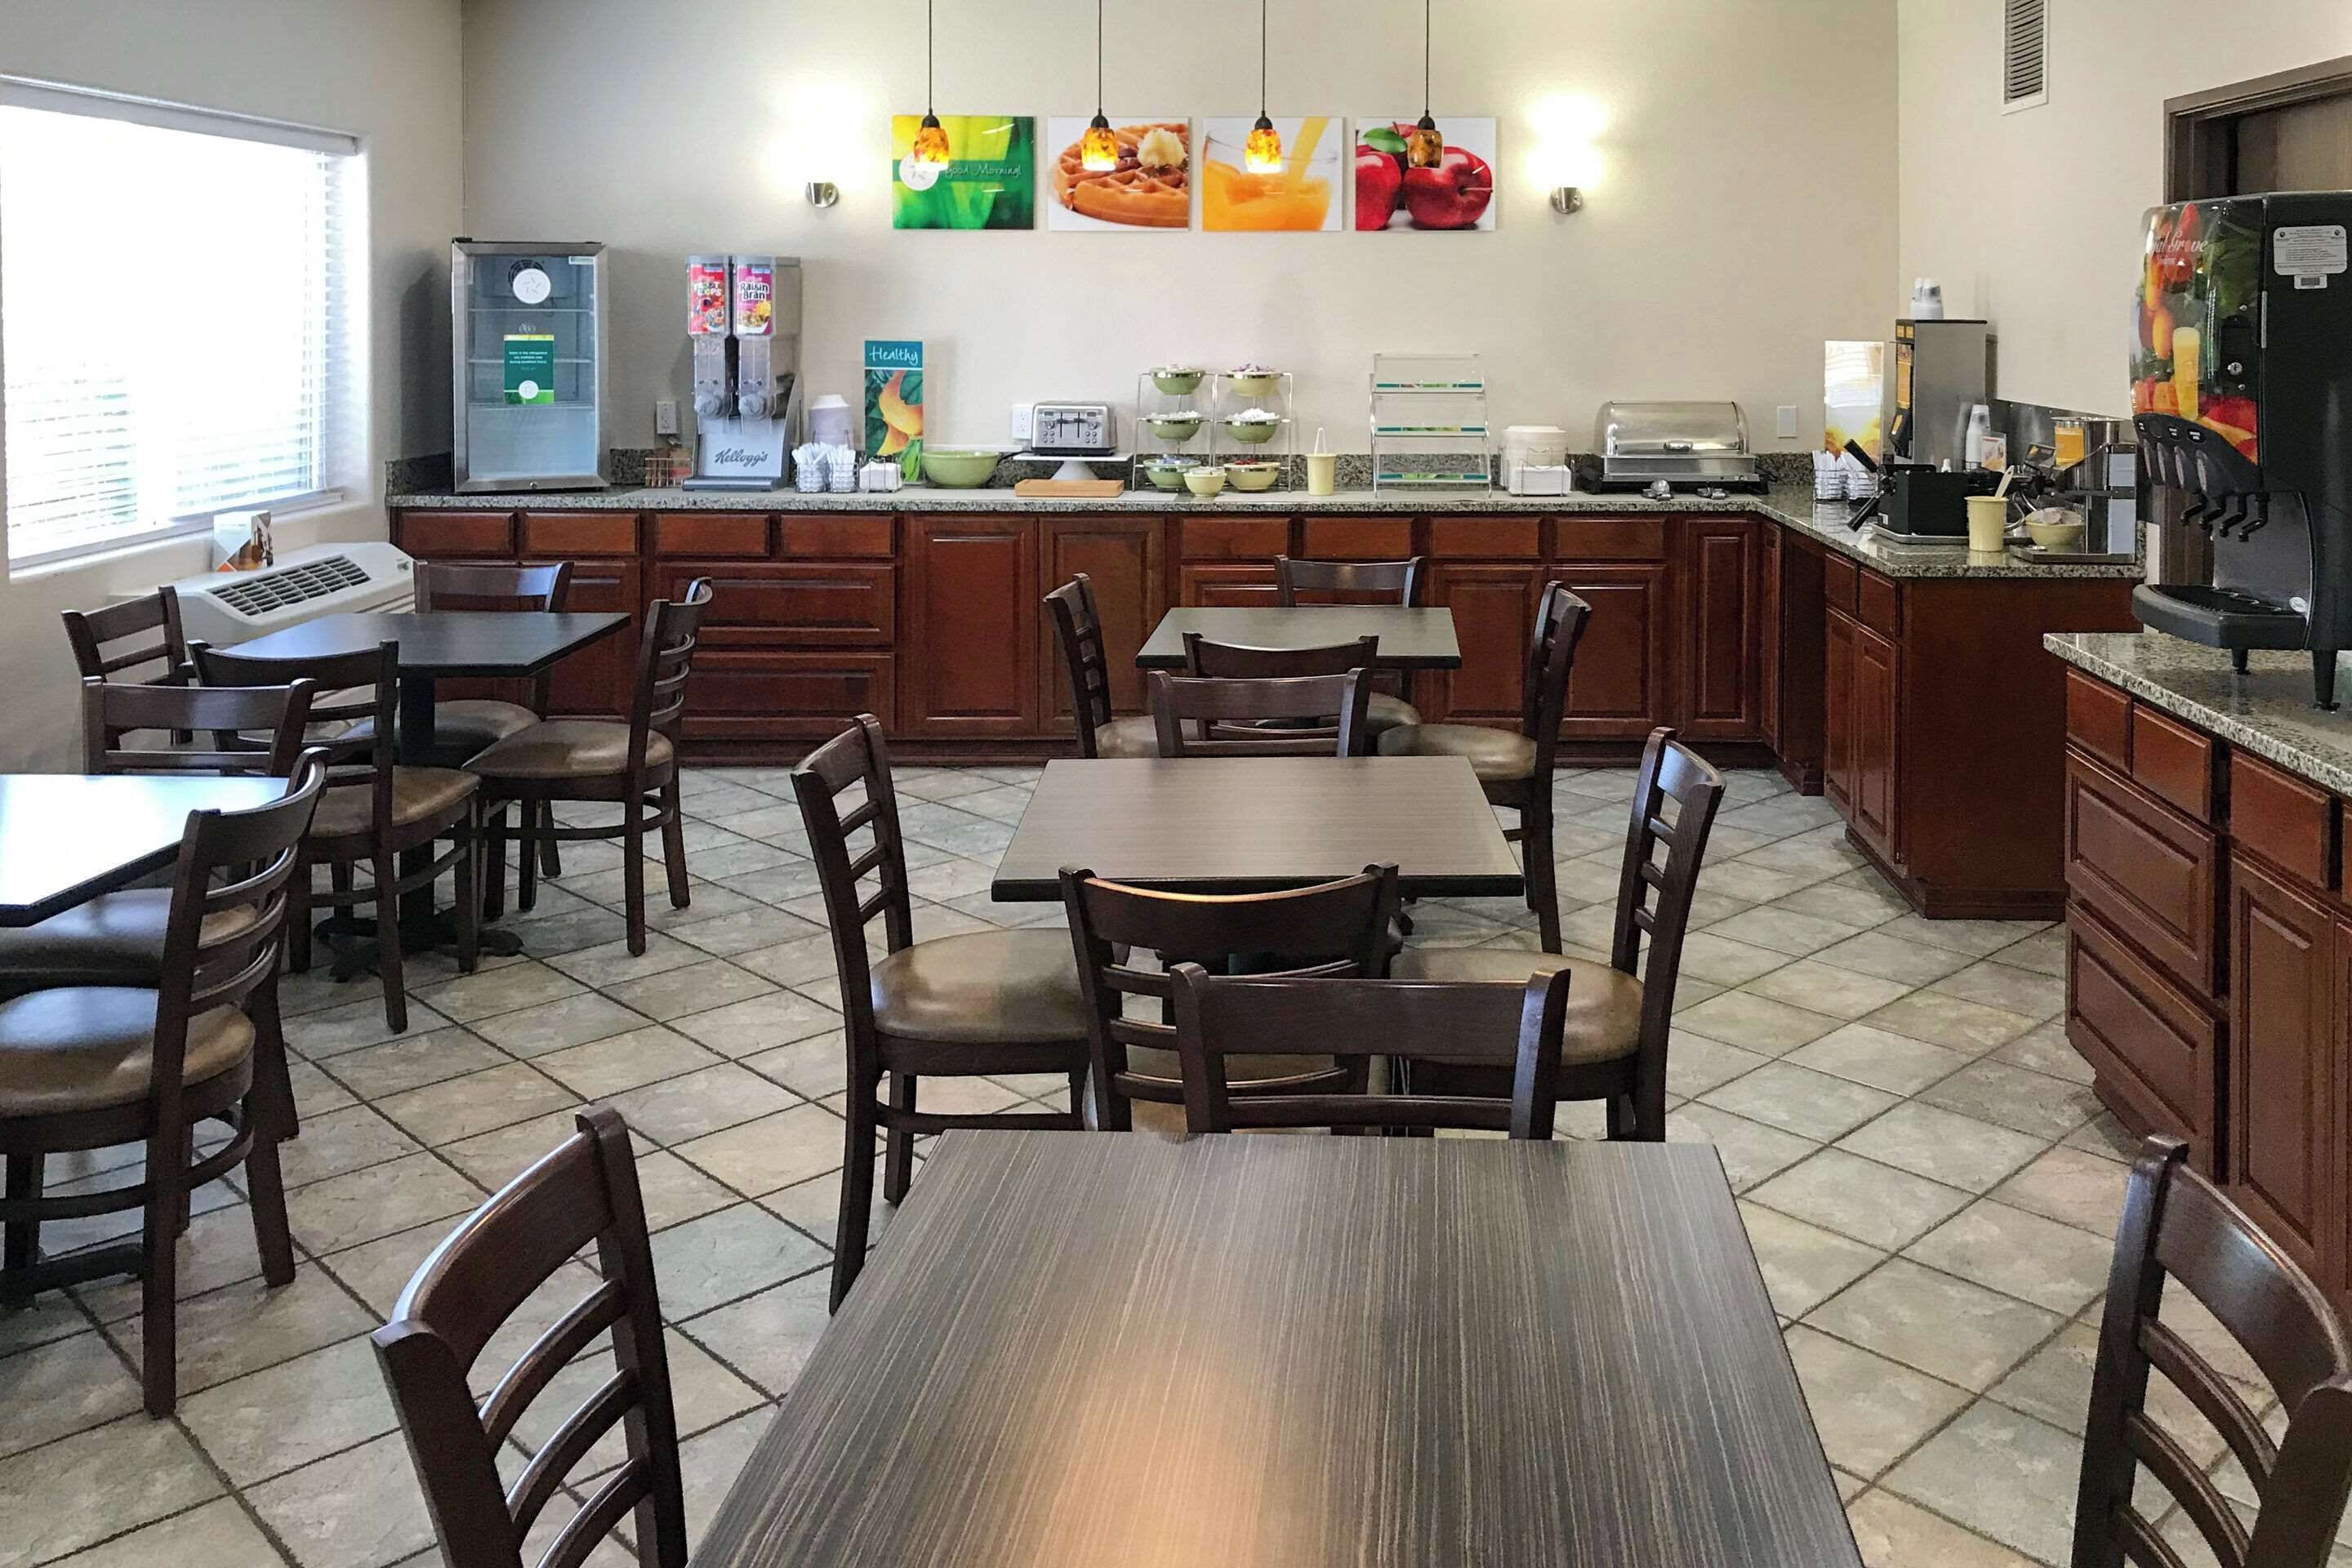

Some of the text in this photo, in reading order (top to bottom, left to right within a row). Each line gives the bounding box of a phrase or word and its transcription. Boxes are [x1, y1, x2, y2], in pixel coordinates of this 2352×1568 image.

[739, 282, 768, 292] Raisin
[742, 290, 765, 301] Bran
[869, 345, 919, 366] Healthy
[715, 448, 768, 467] Kellogg's
